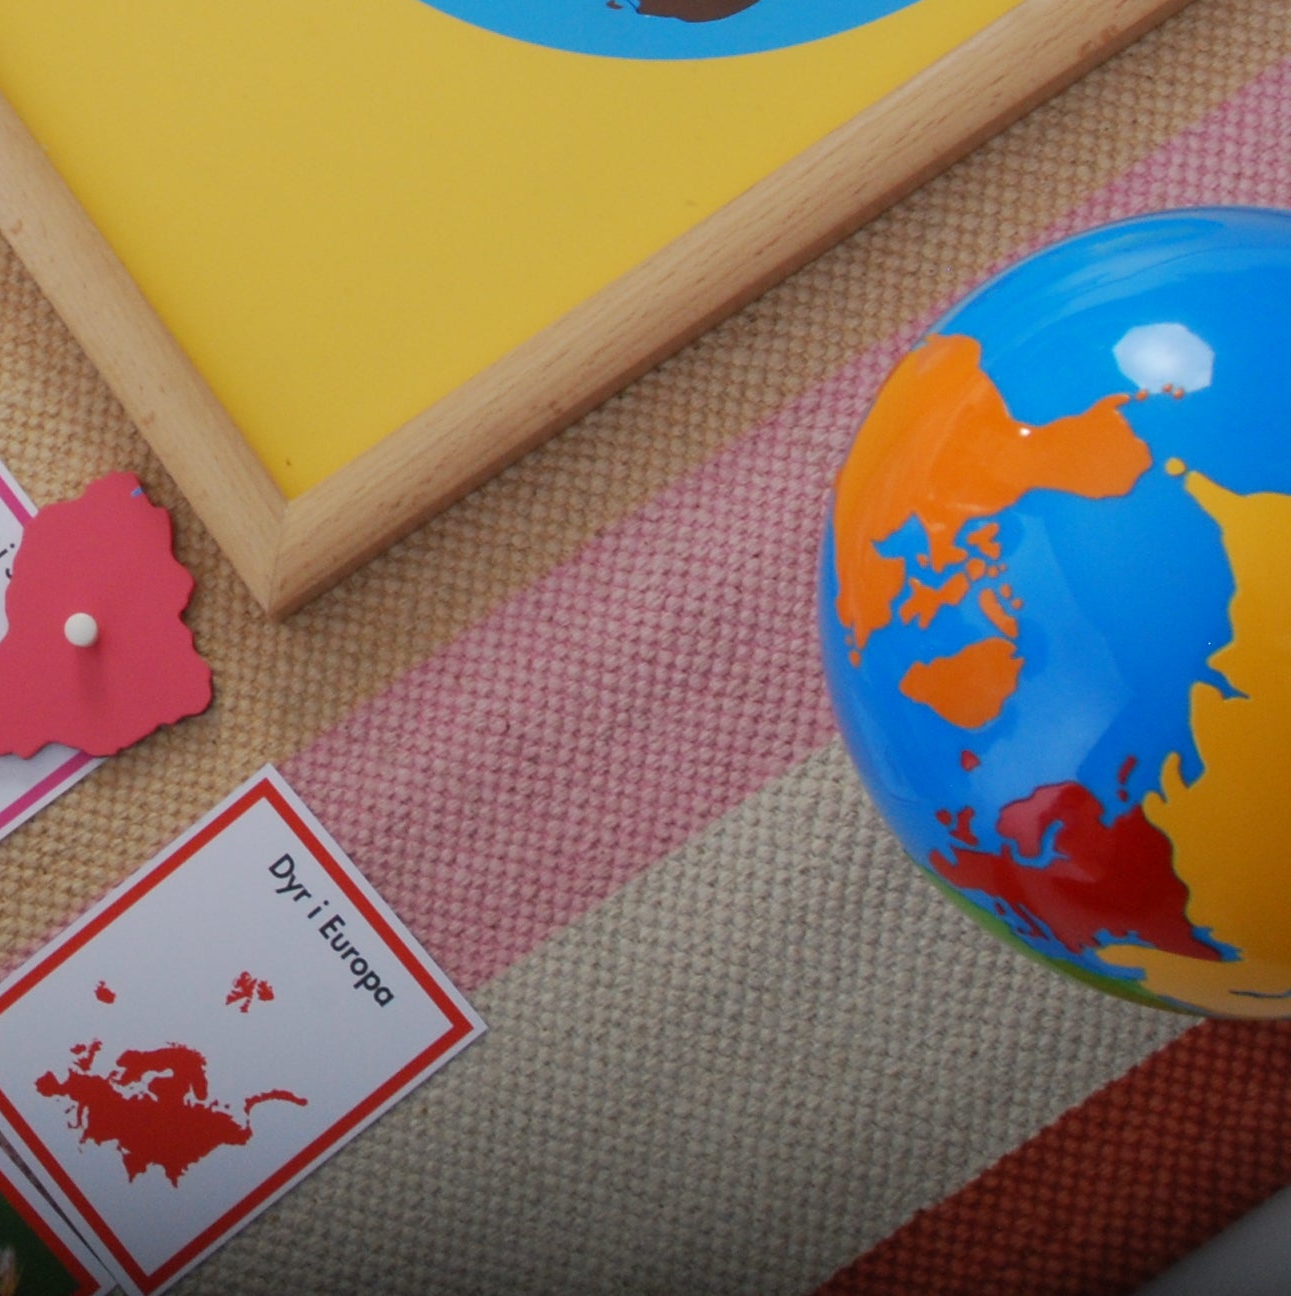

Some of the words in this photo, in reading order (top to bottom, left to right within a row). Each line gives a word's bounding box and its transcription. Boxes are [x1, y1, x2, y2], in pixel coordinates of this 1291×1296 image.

[268, 853, 312, 902] Dyr
[307, 900, 329, 920] i
[319, 914, 395, 1008] Europa
